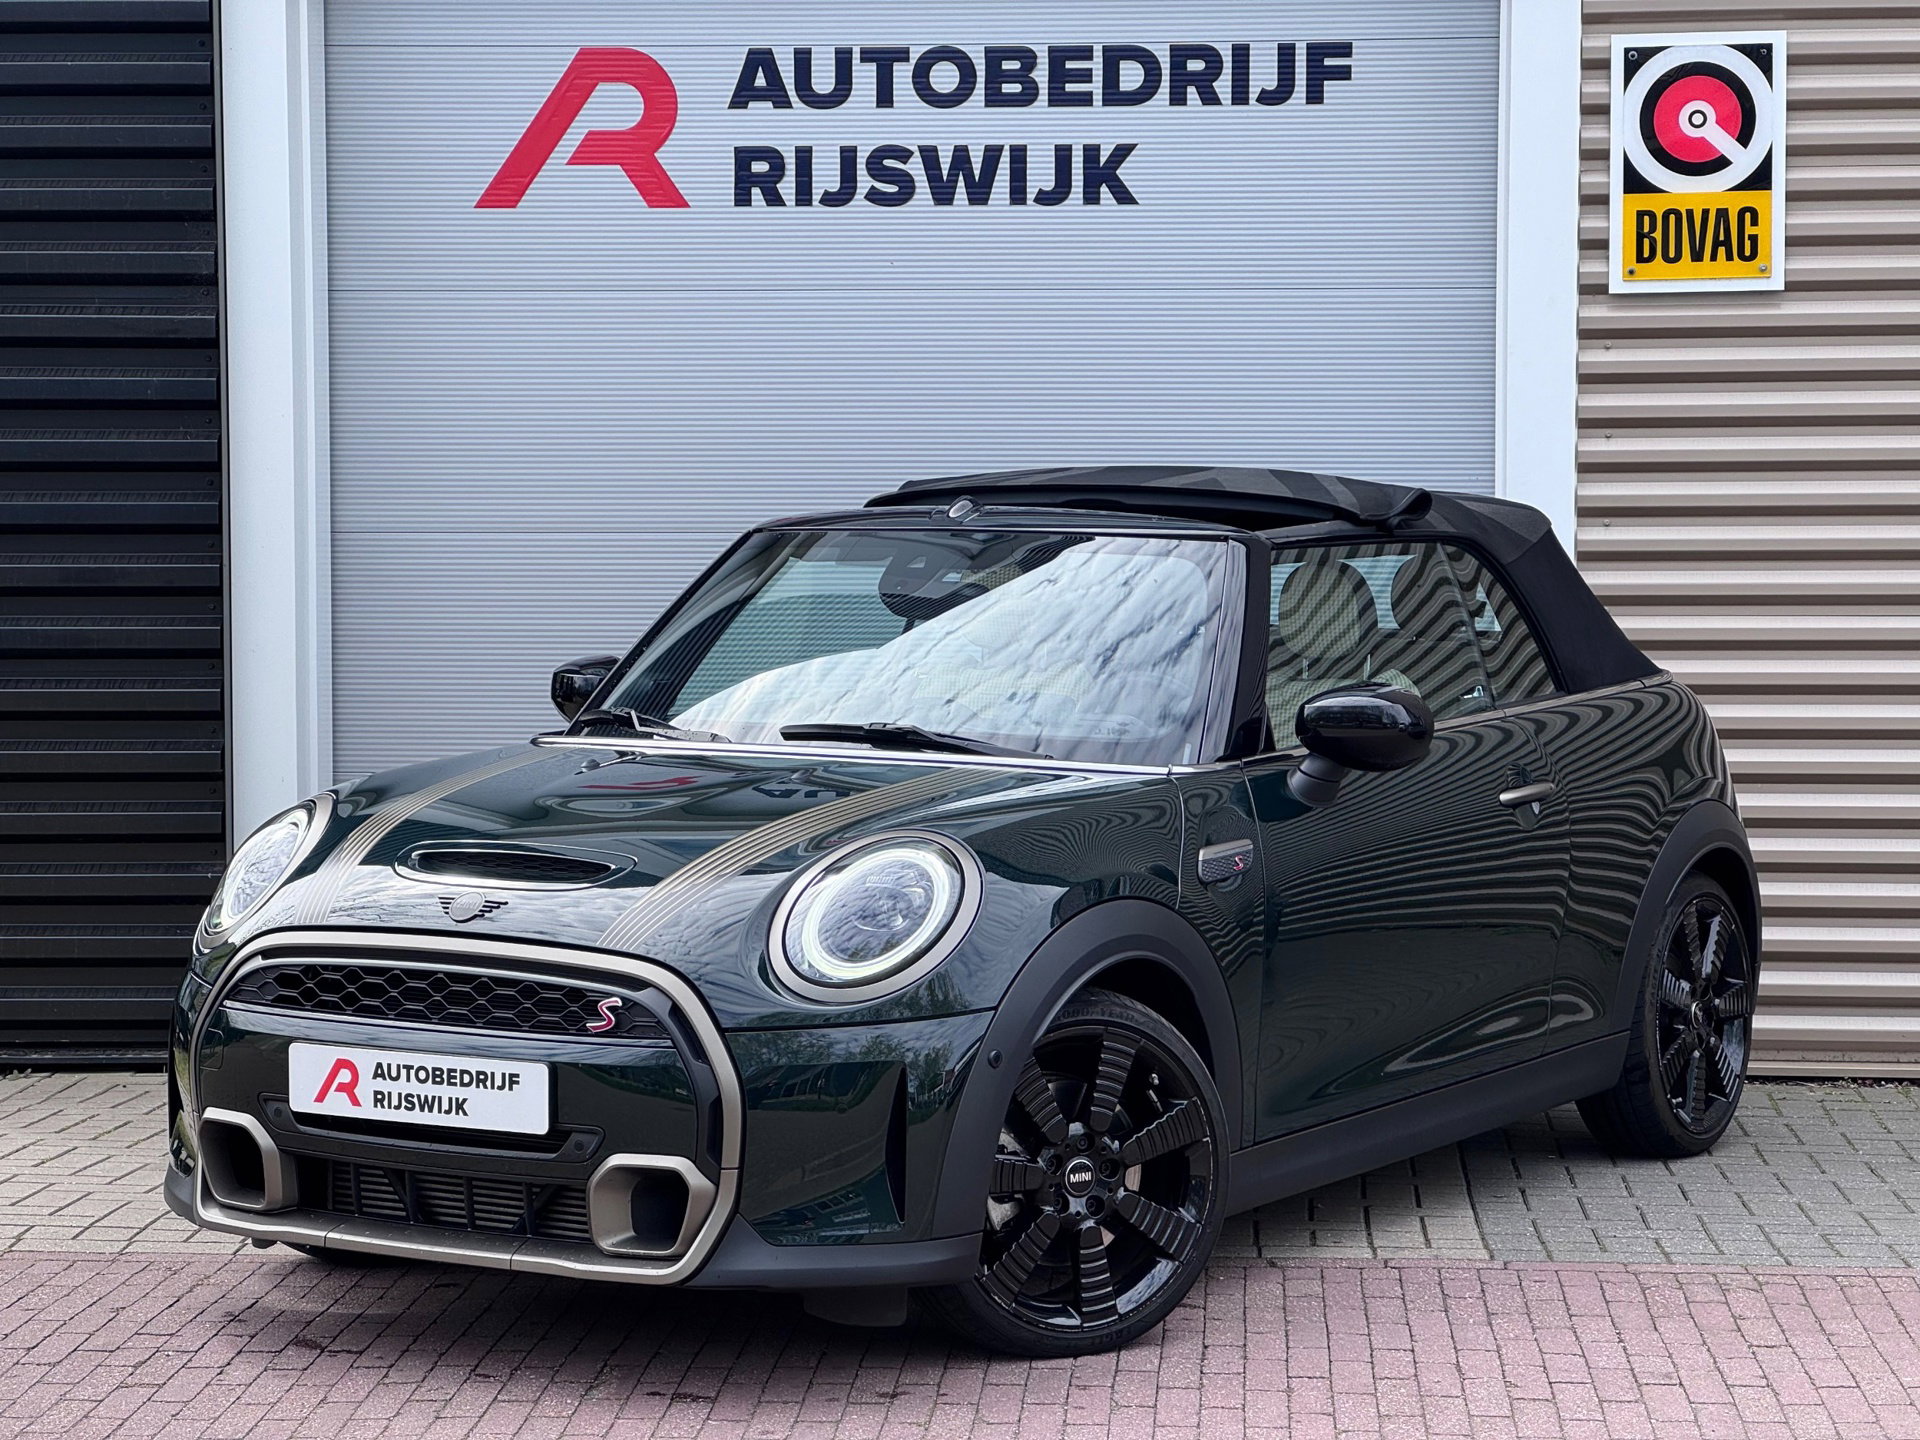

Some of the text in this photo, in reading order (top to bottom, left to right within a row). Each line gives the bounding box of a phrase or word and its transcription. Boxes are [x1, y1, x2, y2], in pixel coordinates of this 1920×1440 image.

[728, 41, 1353, 110] AUTOBEDRIJF
[734, 143, 1140, 208] RIJSWIJK
[1636, 206, 1759, 264] BOVAG
[586, 997, 622, 1032] S
[372, 1061, 521, 1092] AUTOBEDRIJF
[373, 1090, 469, 1117] RIJSWIJK
[1070, 1171, 1092, 1183] MINI
